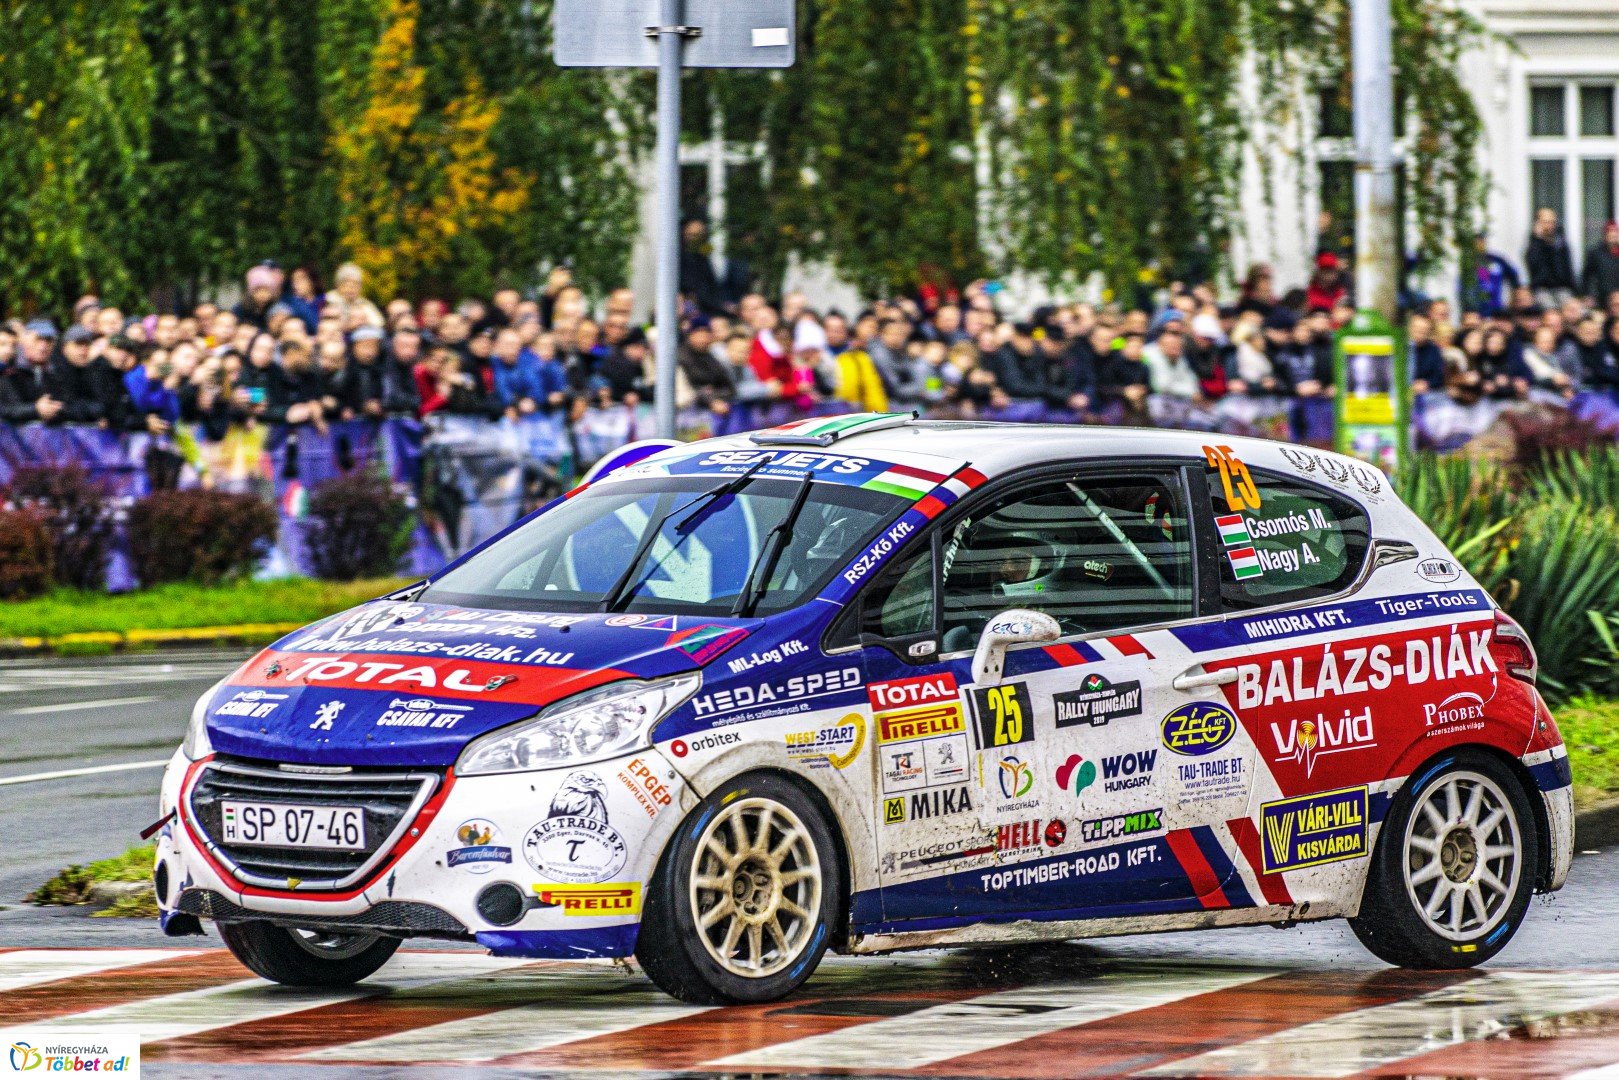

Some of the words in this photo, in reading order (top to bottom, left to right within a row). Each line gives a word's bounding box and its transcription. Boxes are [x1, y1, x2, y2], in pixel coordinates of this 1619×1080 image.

[699, 451, 870, 474] SEAJETS
[1202, 446, 1261, 511] 25
[888, 521, 915, 544] Kft.
[1246, 511, 1309, 539] Csomós
[1311, 508, 1332, 531] M.
[1257, 550, 1300, 573] Nagy
[1303, 543, 1320, 564] A.
[1375, 593, 1478, 617] Tiger-Tools
[1243, 614, 1316, 639] MIHIDRA
[1316, 609, 1351, 631] KFT.
[727, 650, 782, 674] ML-Log
[782, 638, 809, 658] Kft.
[1237, 625, 1499, 710] BALÁZS-DIÁK
[286, 657, 488, 693] TOTAL
[870, 679, 956, 706] TOTAL
[1057, 701, 1090, 721] RALLY
[1091, 688, 1140, 715] HUNGARY
[376, 709, 436, 727] CSAVAR
[429, 713, 465, 729] KFT
[880, 706, 959, 741] PIRELLI
[987, 685, 1023, 747] 25
[1214, 716, 1226, 726] KFT
[1423, 702, 1485, 727] PHOBEX
[691, 730, 742, 752] orbitex
[784, 726, 855, 745] WEST-START
[902, 767, 923, 776] RACING
[1102, 749, 1158, 779] WOW
[1178, 759, 1229, 781] TAU-TRADE
[1231, 757, 1246, 774] BT.
[617, 772, 647, 806] KOMPLEX
[627, 758, 673, 806] ÉPGÉP
[1104, 776, 1152, 793] HUNGARY
[1185, 774, 1241, 790] www.tautrade.hu
[911, 787, 972, 821] MIKA
[996, 799, 1041, 814] NYÍREGYHÁZA
[1297, 799, 1362, 833] VÁRI-VILL
[226, 825, 236, 839] H
[242, 807, 276, 842] SP
[285, 808, 359, 846] 07-46
[527, 817, 608, 848] TAU-TRADE
[608, 832, 625, 858] BT.
[996, 819, 1042, 850] HELL
[900, 839, 964, 860] PEUGEOT
[1297, 834, 1361, 860] KISVÁRDA
[981, 854, 1120, 892] TOPTIMBER-ROAD
[1127, 845, 1162, 867] KFT.
